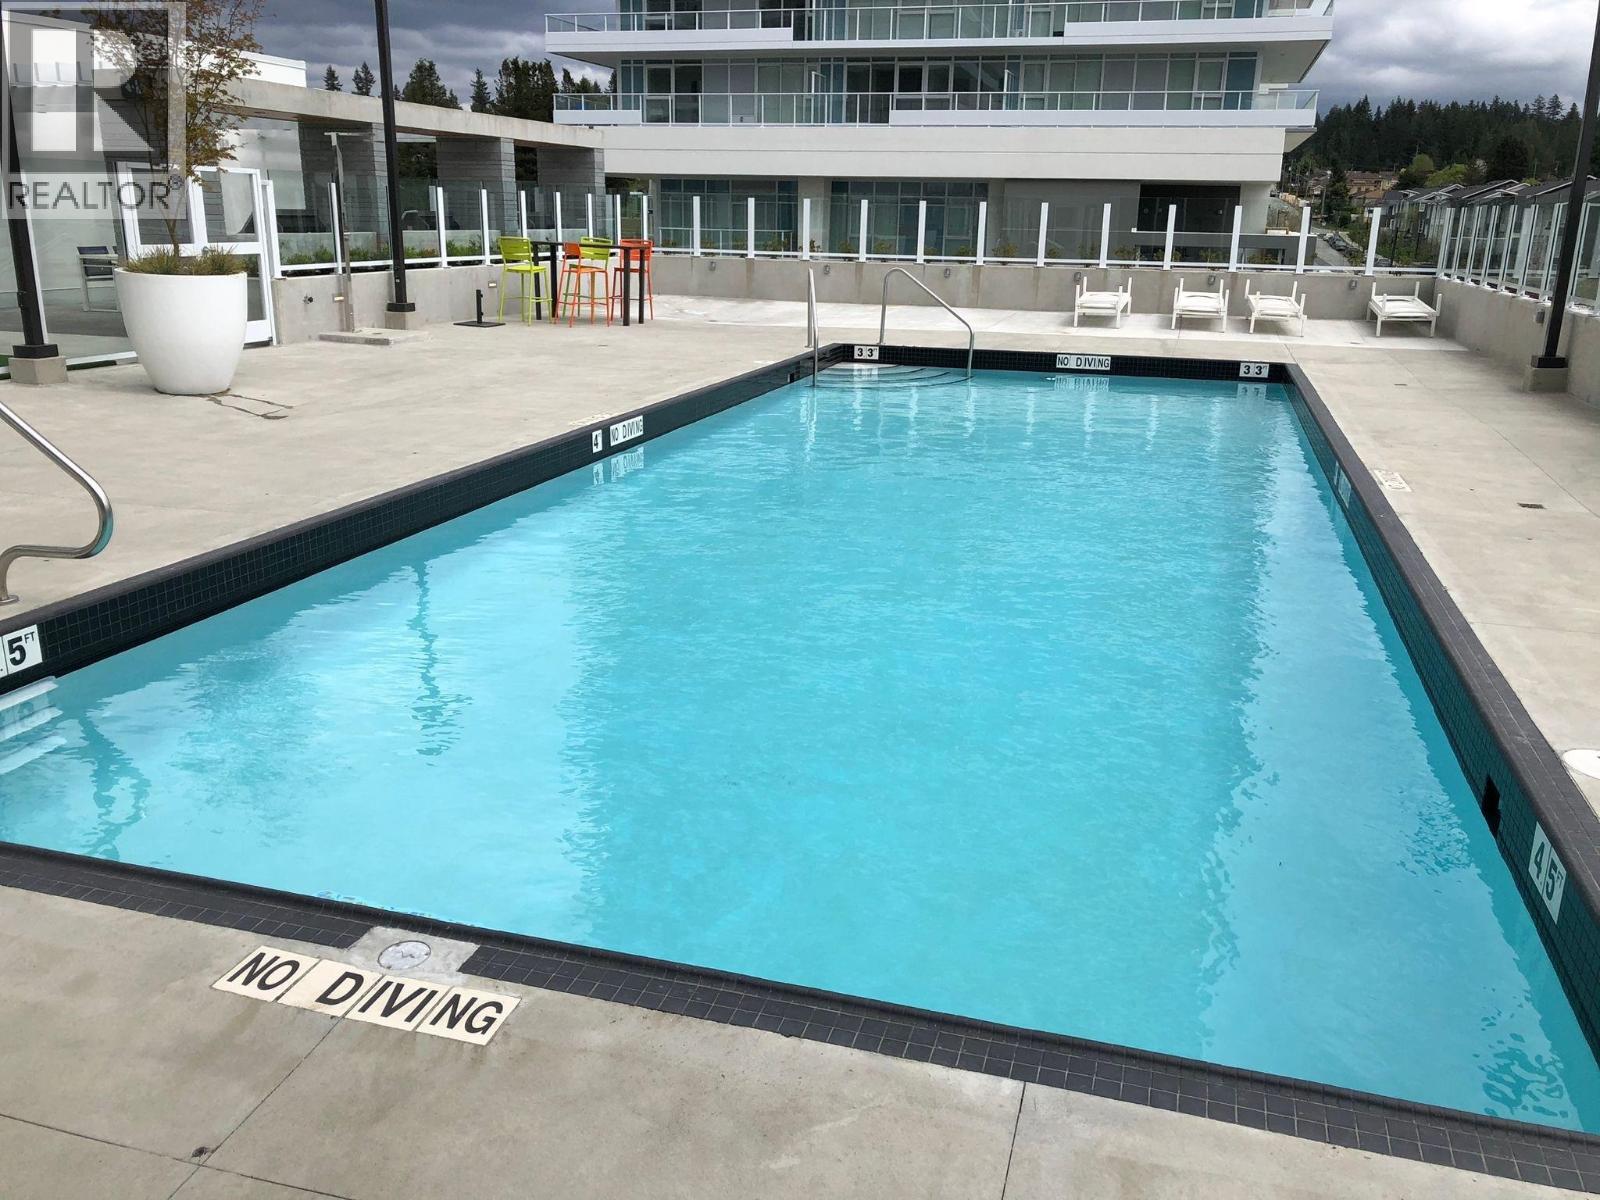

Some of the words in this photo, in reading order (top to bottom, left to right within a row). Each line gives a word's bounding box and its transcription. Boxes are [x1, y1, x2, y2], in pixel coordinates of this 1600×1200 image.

[1057, 356, 1069, 367] NO
[1075, 357, 1110, 368] DIVING
[227, 951, 300, 991] NO
[314, 970, 504, 1036] DIVING
